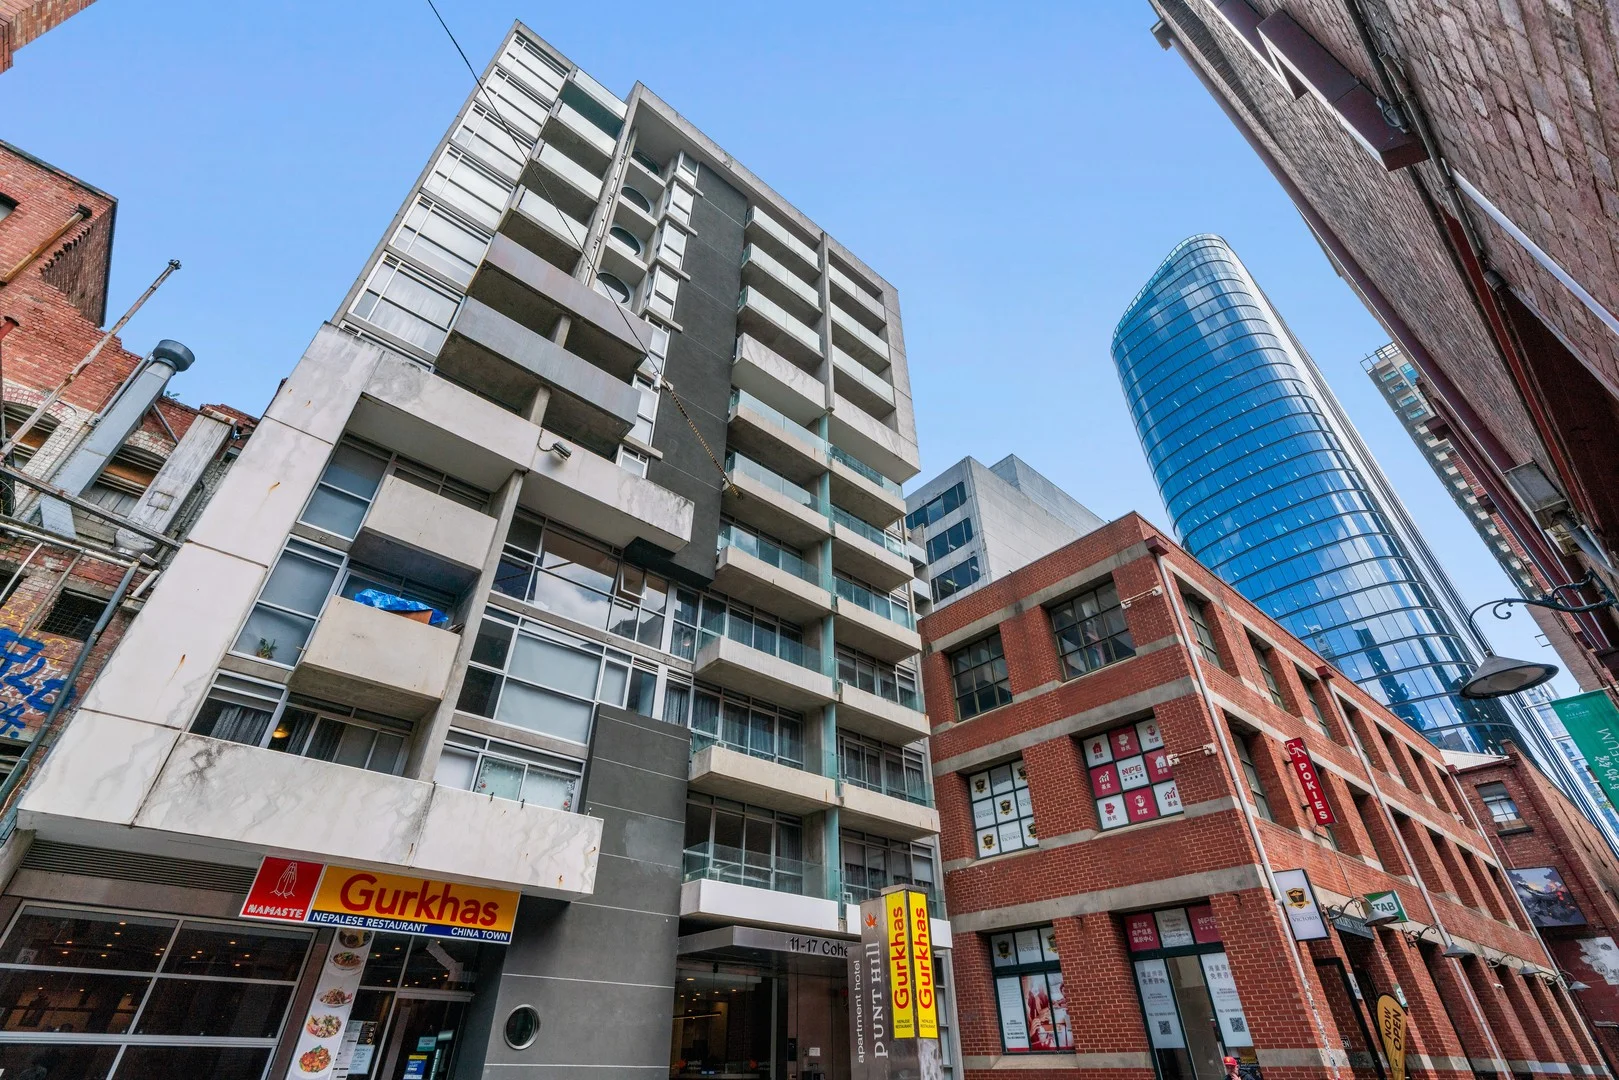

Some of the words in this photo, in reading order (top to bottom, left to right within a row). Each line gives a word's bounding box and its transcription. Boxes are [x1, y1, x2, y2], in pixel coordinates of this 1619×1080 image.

[1121, 764, 1142, 776] NPG
[1298, 762, 1328, 820] POKIES
[246, 904, 304, 918] NAMASTE
[340, 873, 499, 926] Gurkhas
[1373, 901, 1396, 912] TAB
[312, 912, 365, 926] NEPALESE
[366, 916, 428, 933] RESTAURANT
[451, 927, 479, 938] CHINA
[481, 931, 508, 941] TOWN
[1197, 916, 1217, 925] NPG
[790, 937, 818, 952] 11-17
[890, 906, 910, 1009] Gurkhas
[914, 907, 933, 1009] Gurkhas
[853, 960, 861, 991] hotel
[855, 995, 865, 1063] apartment
[1384, 1006, 1392, 1040] NOW
[1393, 1008, 1402, 1052] OPEN
